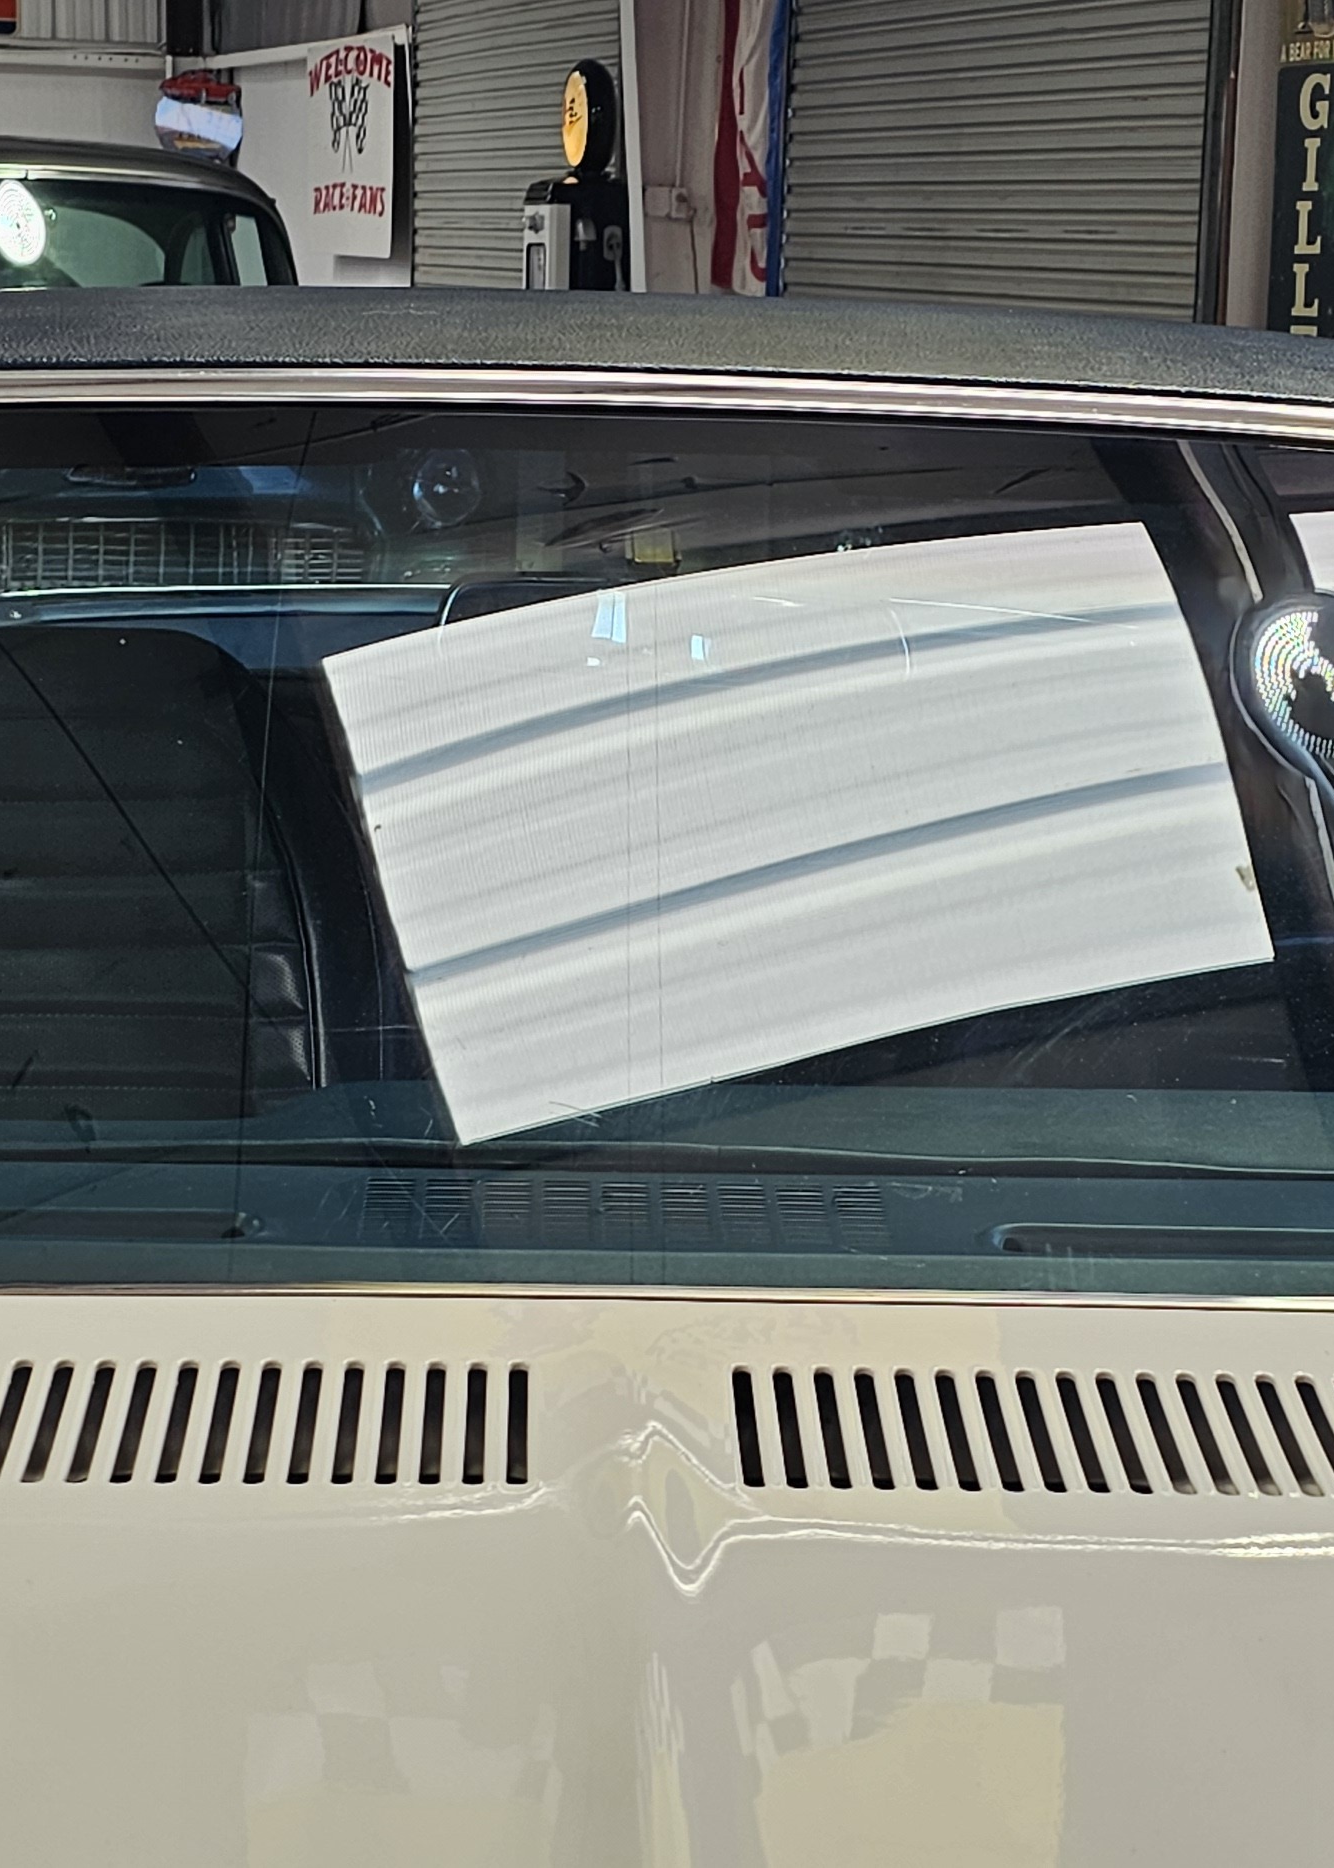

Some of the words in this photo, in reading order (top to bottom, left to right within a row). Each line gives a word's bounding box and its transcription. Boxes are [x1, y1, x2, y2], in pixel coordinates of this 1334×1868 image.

[309, 45, 393, 98] WELCOME
[1289, 41, 1312, 62] BEAR
[313, 181, 346, 215] RACE
[350, 183, 386, 218] FANS
[1290, 73, 1332, 337] GILL
